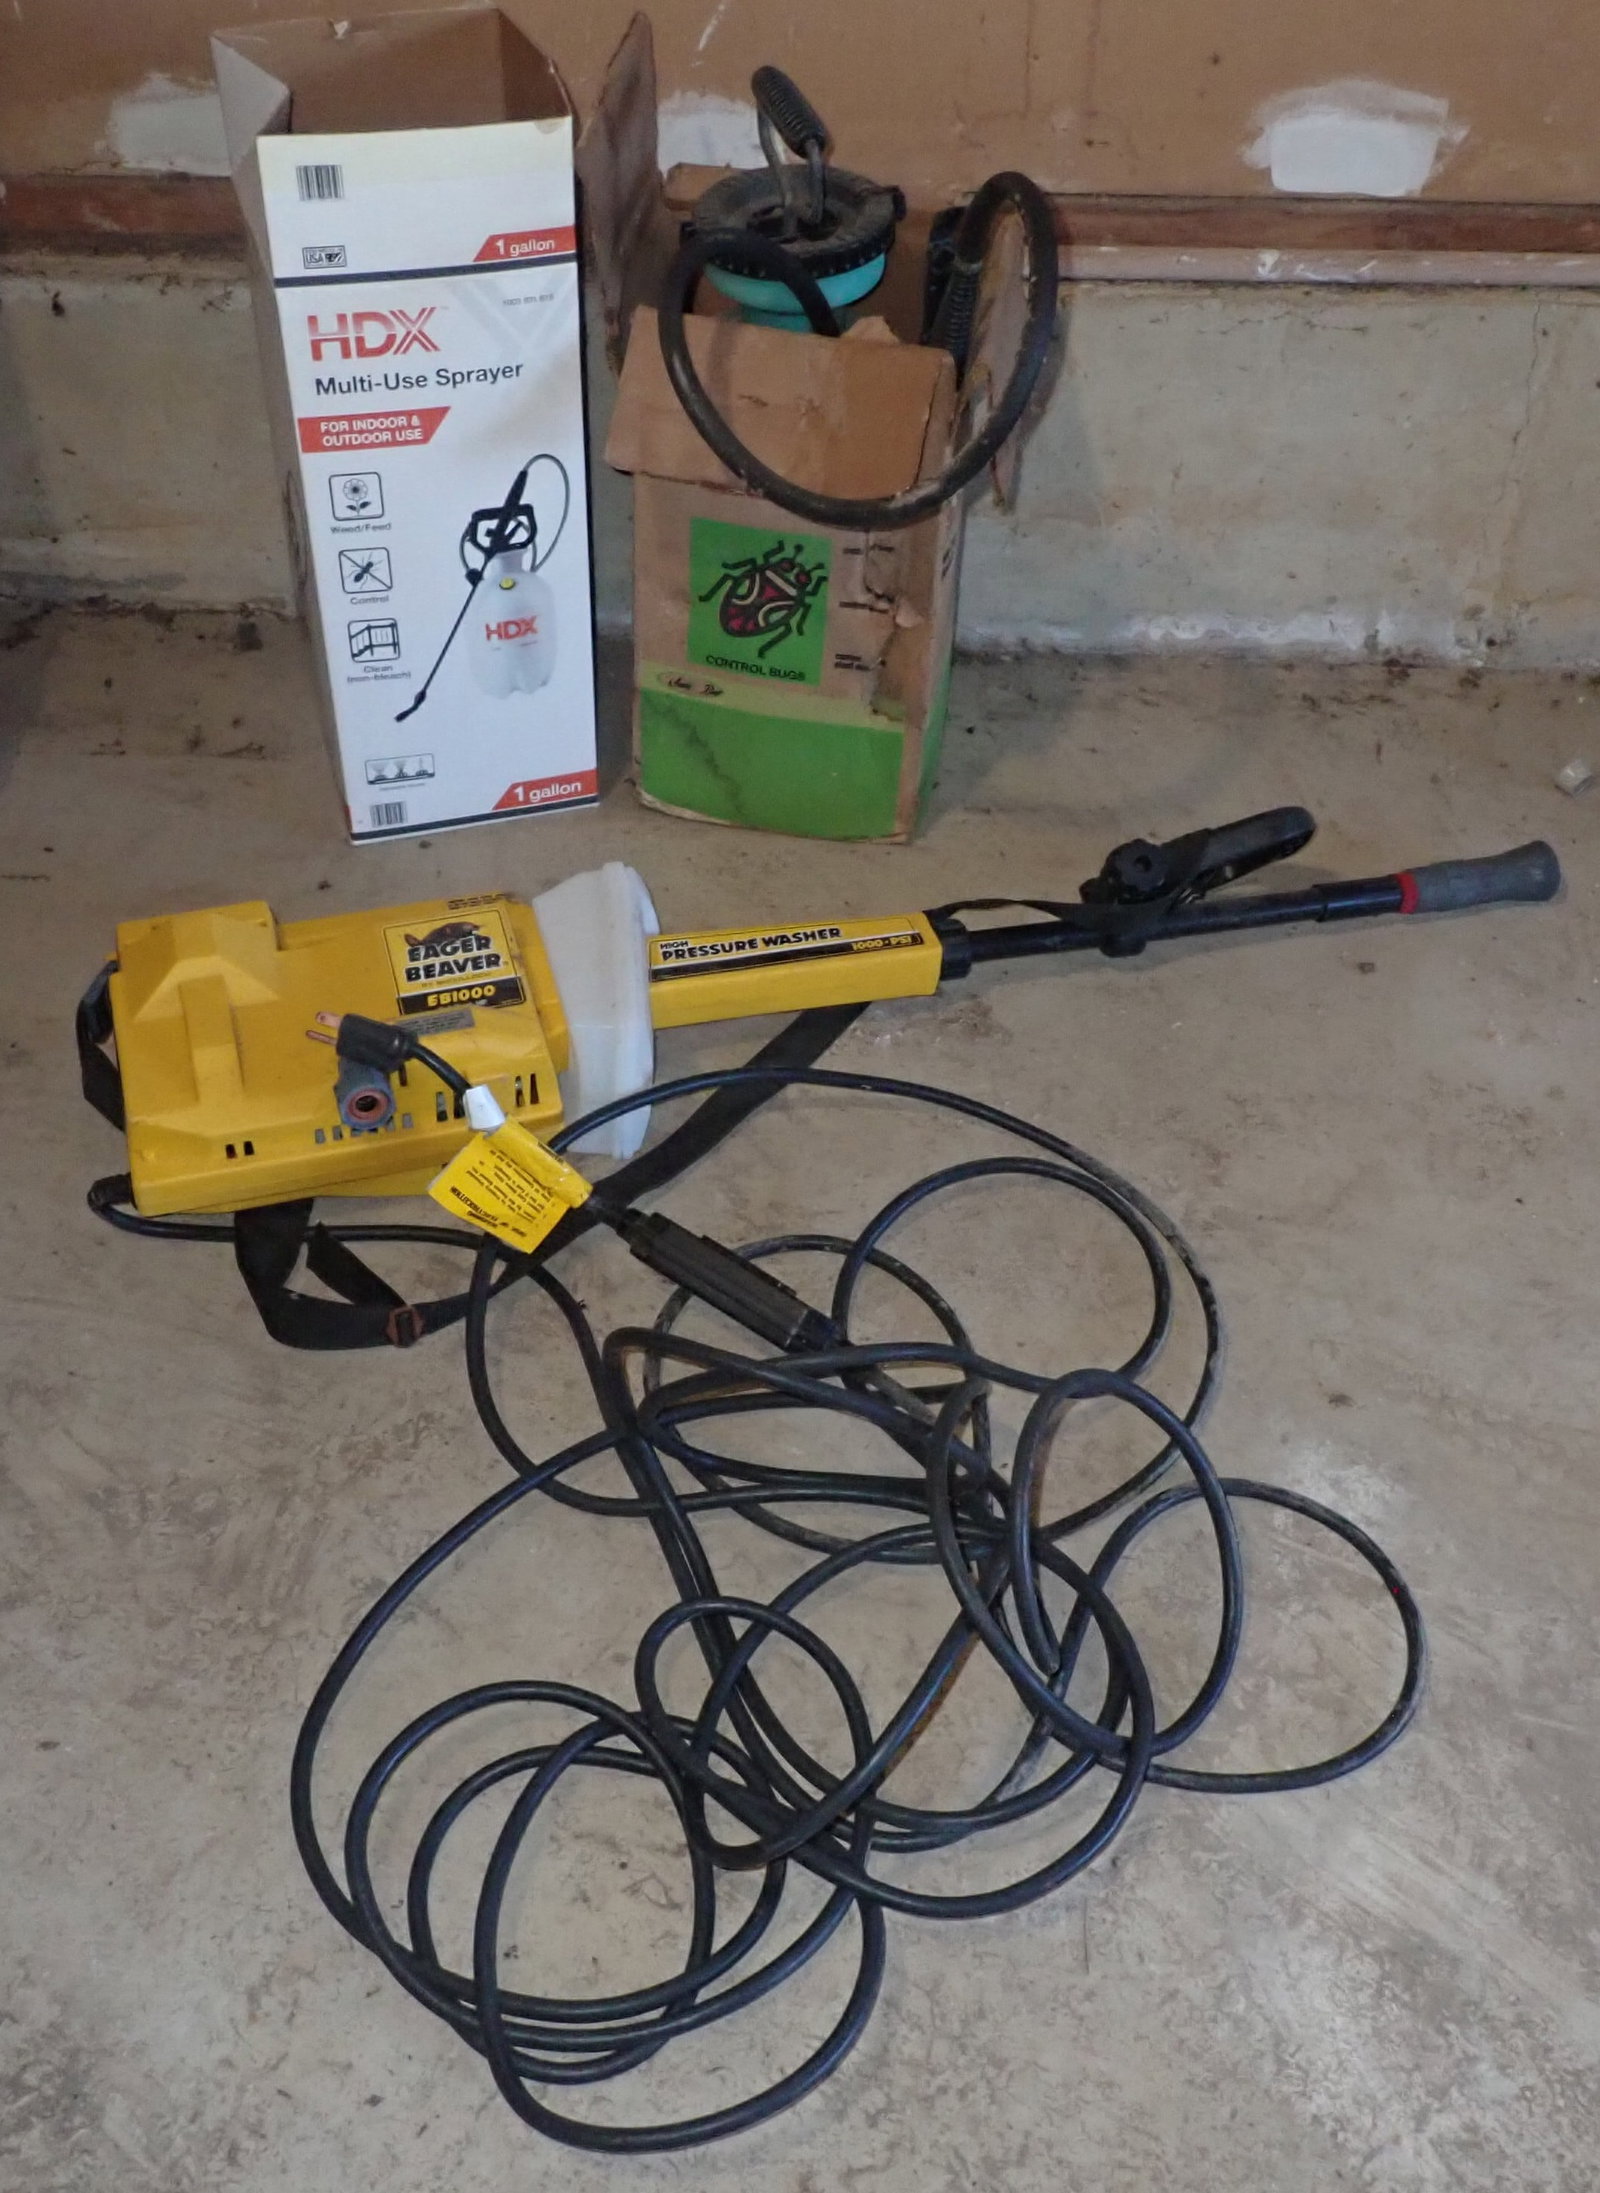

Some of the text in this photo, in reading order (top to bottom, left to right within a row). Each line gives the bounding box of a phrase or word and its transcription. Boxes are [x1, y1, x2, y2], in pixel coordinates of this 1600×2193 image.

[496, 239, 555, 257] 1 gallon
[307, 306, 440, 362] HDX
[315, 363, 524, 396] Multi-Use Sprayer
[320, 415, 421, 433] FOR INDOOR &
[322, 429, 423, 447] OUTDOOR USE
[485, 615, 538, 641] HDX
[705, 654, 766, 676] CONTROL
[514, 781, 582, 803] 1 gallon
[407, 936, 492, 963] EAGER
[660, 940, 689, 950] HIGH
[662, 927, 841, 961] PRESSURE WASHER
[405, 953, 501, 983] BEAVER
[426, 984, 496, 1007] EB1000
